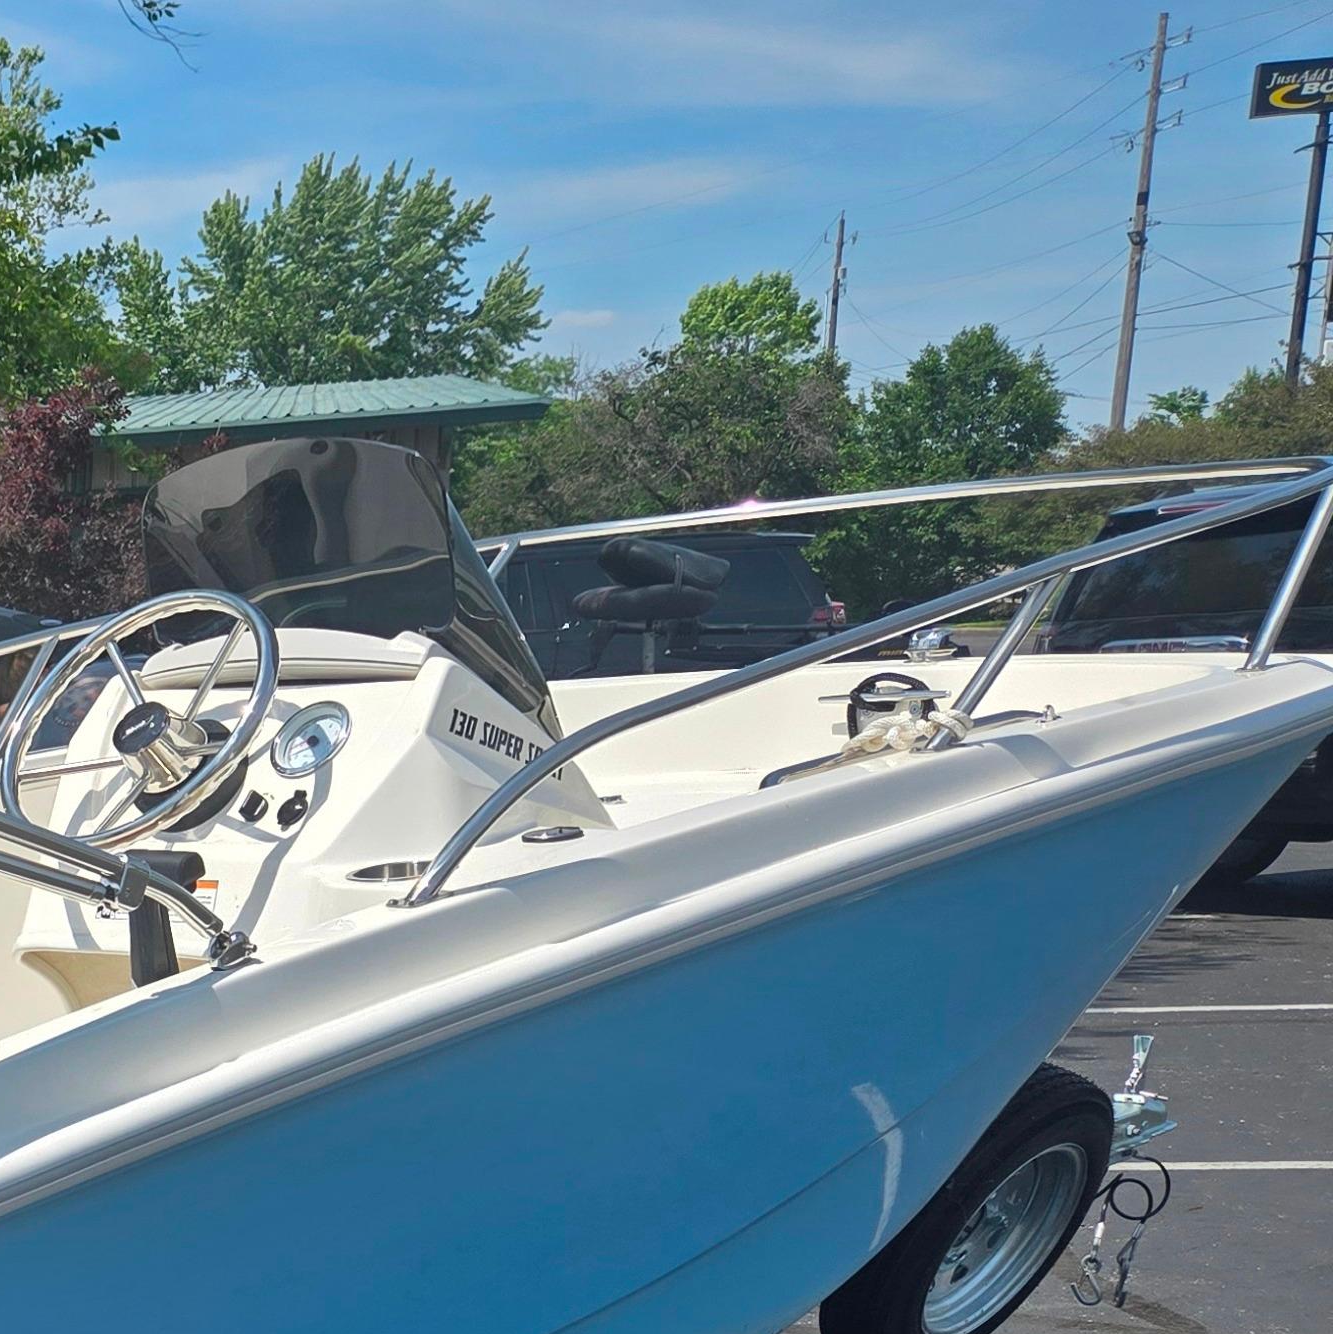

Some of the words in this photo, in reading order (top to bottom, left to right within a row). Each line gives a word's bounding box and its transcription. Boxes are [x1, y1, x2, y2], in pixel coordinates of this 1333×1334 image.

[1266, 72, 1299, 89] Just
[1297, 68, 1328, 83] Add
[449, 708, 478, 741] 130
[479, 721, 524, 761] SUPER
